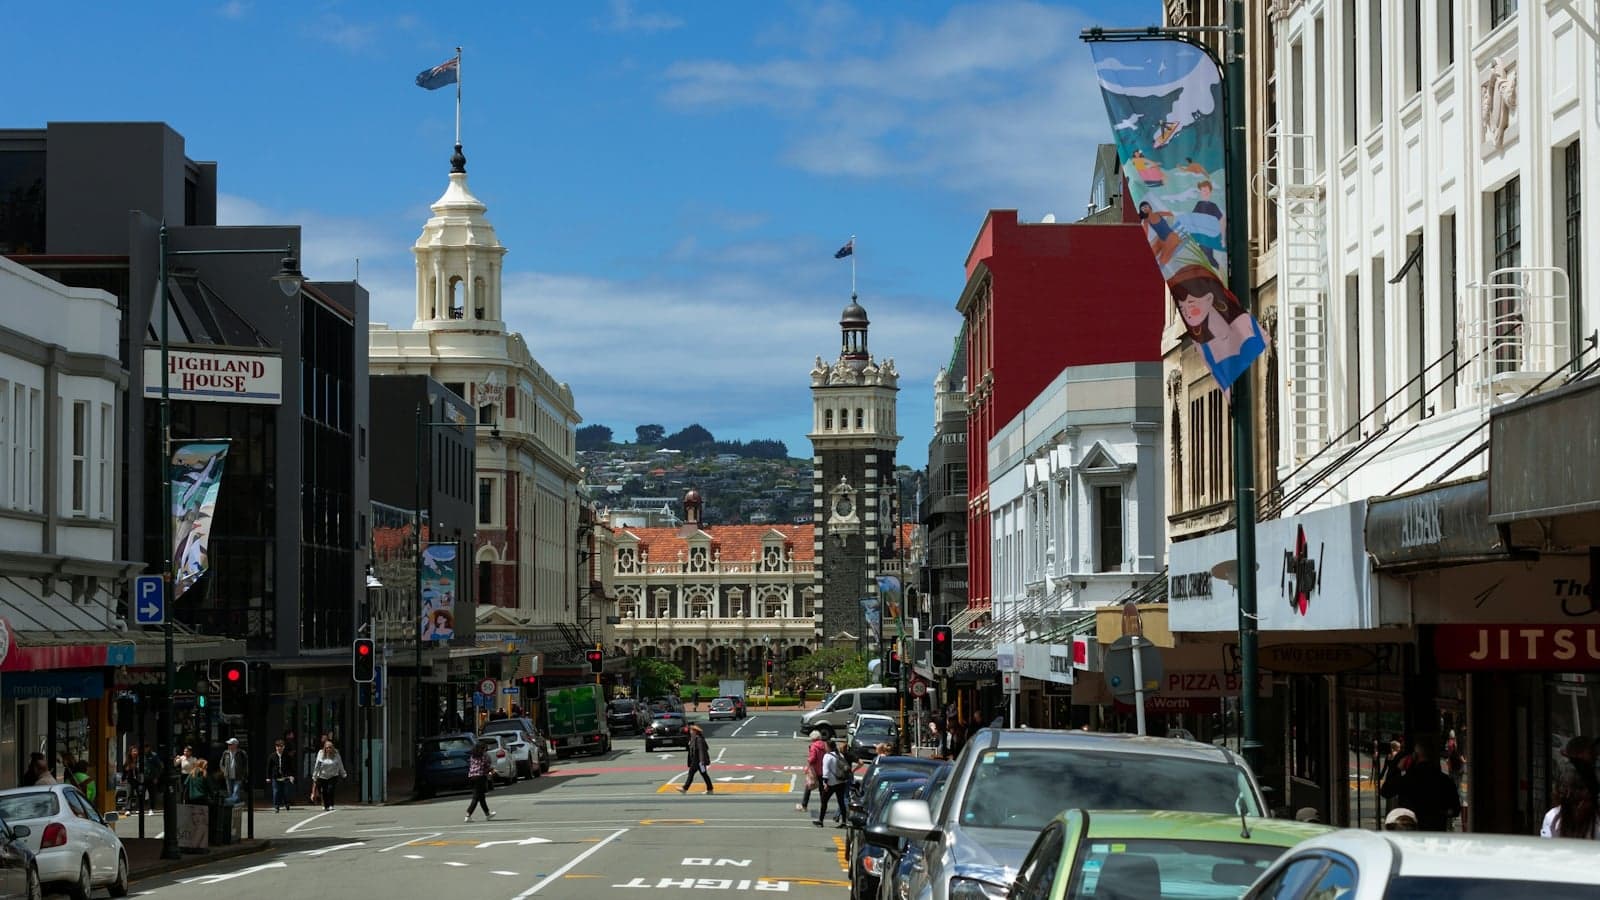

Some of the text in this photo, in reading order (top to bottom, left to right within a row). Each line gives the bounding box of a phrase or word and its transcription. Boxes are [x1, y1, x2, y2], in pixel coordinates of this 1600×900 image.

[168, 356, 265, 378] HIGHLAND
[182, 373, 246, 392] HOUSE
[142, 582, 156, 599] P
[1169, 673, 1265, 691] PIZZA BR
[13, 683, 62, 698] mortgage
[1153, 697, 1190, 710] Worth
[681, 858, 752, 867] NO
[611, 878, 790, 892] RIGHT
